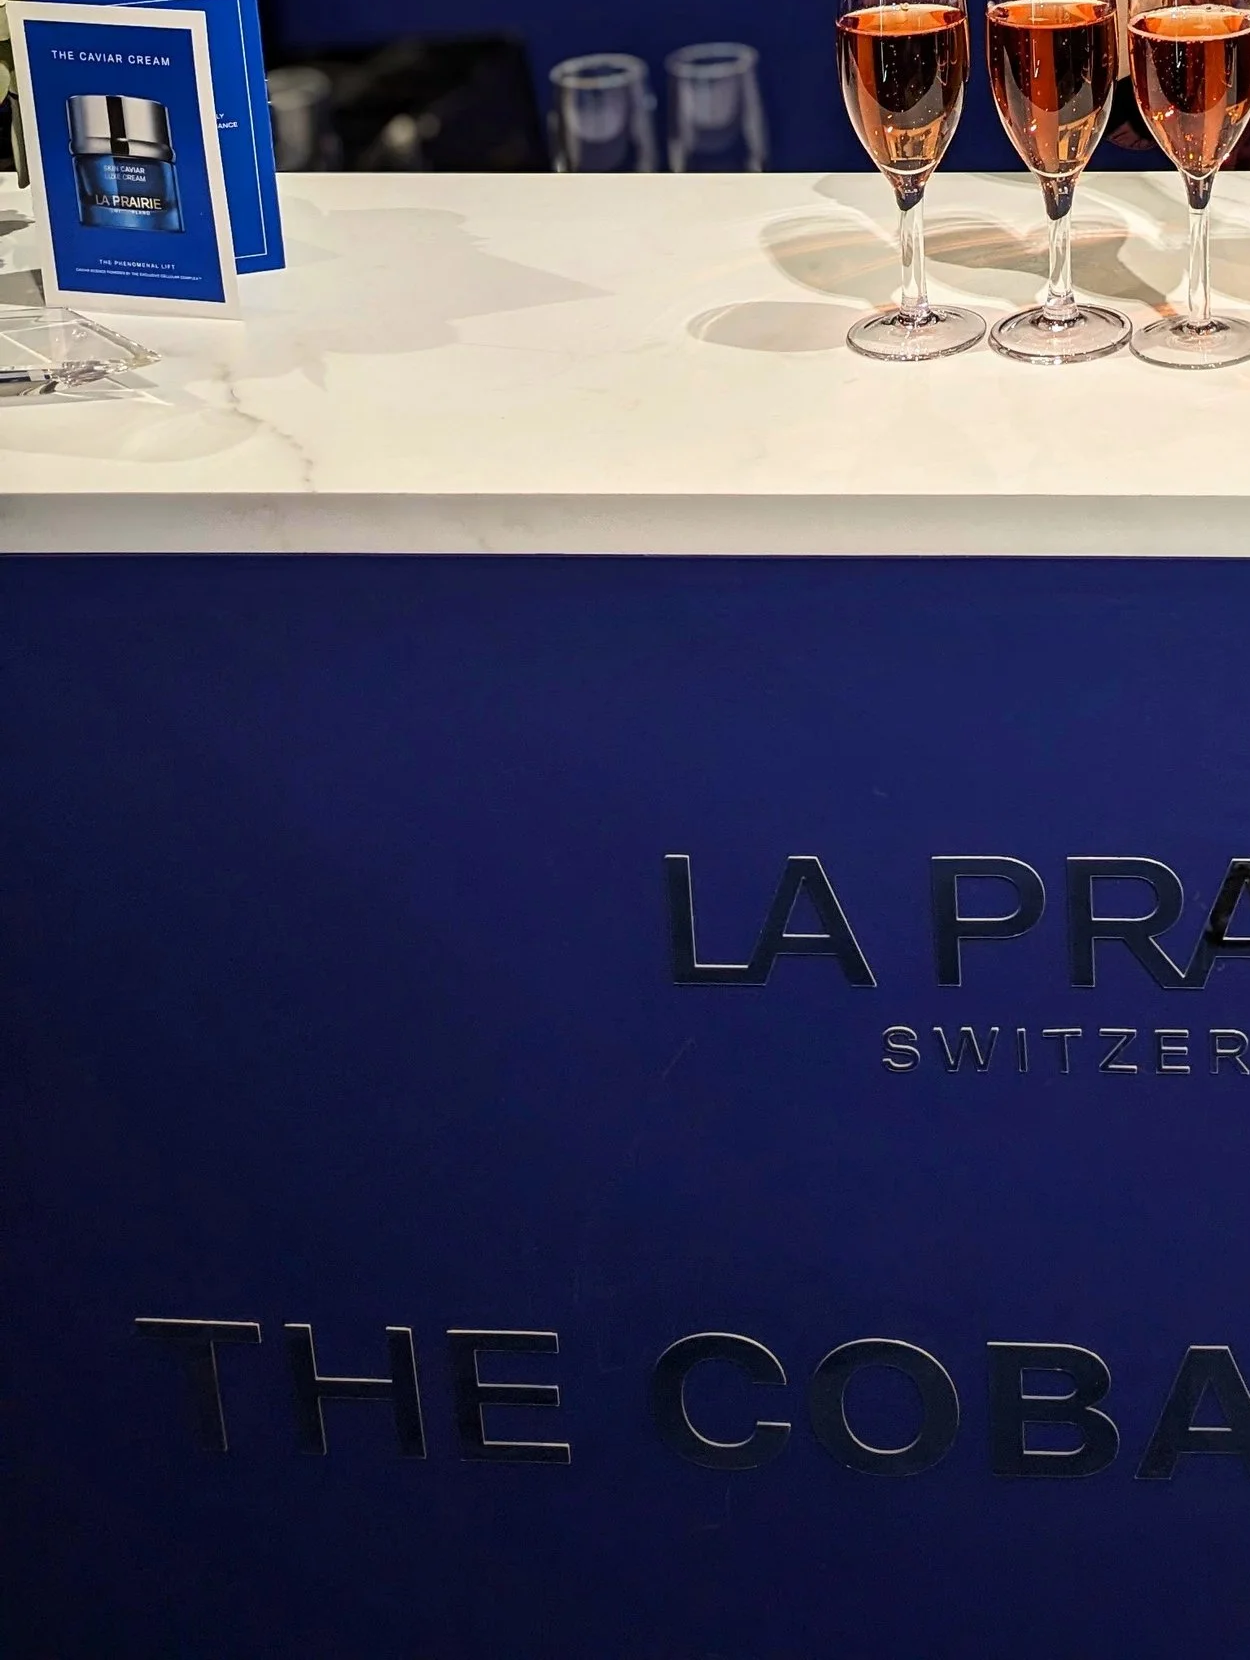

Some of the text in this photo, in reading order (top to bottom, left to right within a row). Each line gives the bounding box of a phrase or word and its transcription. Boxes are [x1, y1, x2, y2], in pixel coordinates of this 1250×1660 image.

[51, 50, 170, 66] THE CAVIAR CREAM
[120, 165, 145, 174] CAVIAR
[95, 194, 162, 210] LA PRAIRIE
[114, 260, 159, 270] PHENOMENAL
[664, 853, 878, 988] LA
[134, 1317, 572, 1465] THE
